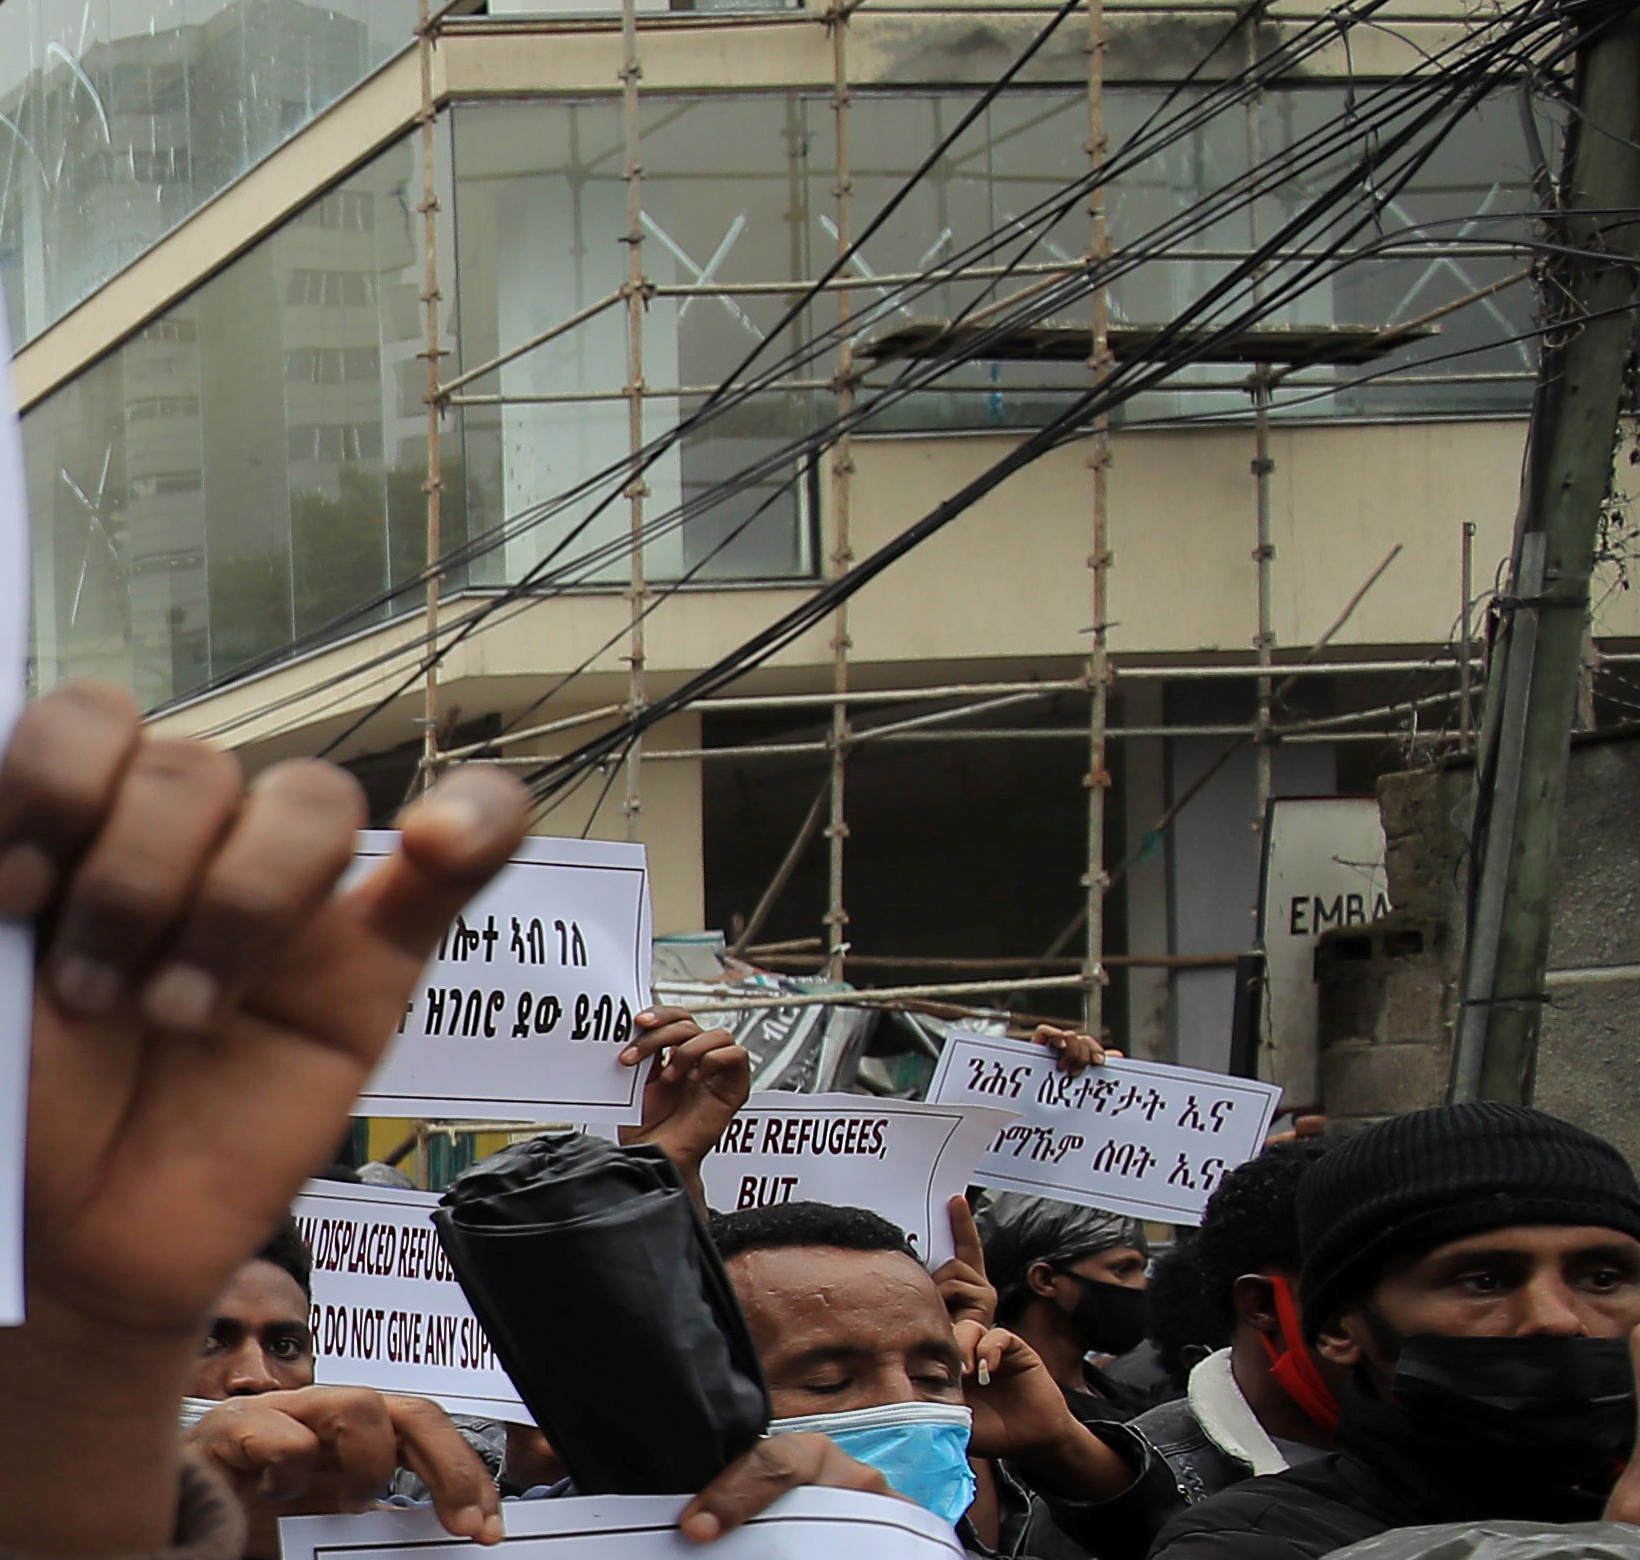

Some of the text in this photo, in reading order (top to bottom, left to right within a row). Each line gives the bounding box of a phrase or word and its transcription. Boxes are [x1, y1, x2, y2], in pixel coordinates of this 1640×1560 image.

[1290, 893, 1388, 936] EMBA
[762, 1119, 888, 1159] REFUGEES,
[737, 1176, 798, 1210] BUT
[316, 1219, 396, 1276] DISPLACED
[398, 1227, 457, 1282] REFUG
[324, 1305, 347, 1355] DO
[351, 1308, 383, 1360] NOT
[388, 1311, 421, 1364] GIVE
[424, 1315, 457, 1366] ANY
